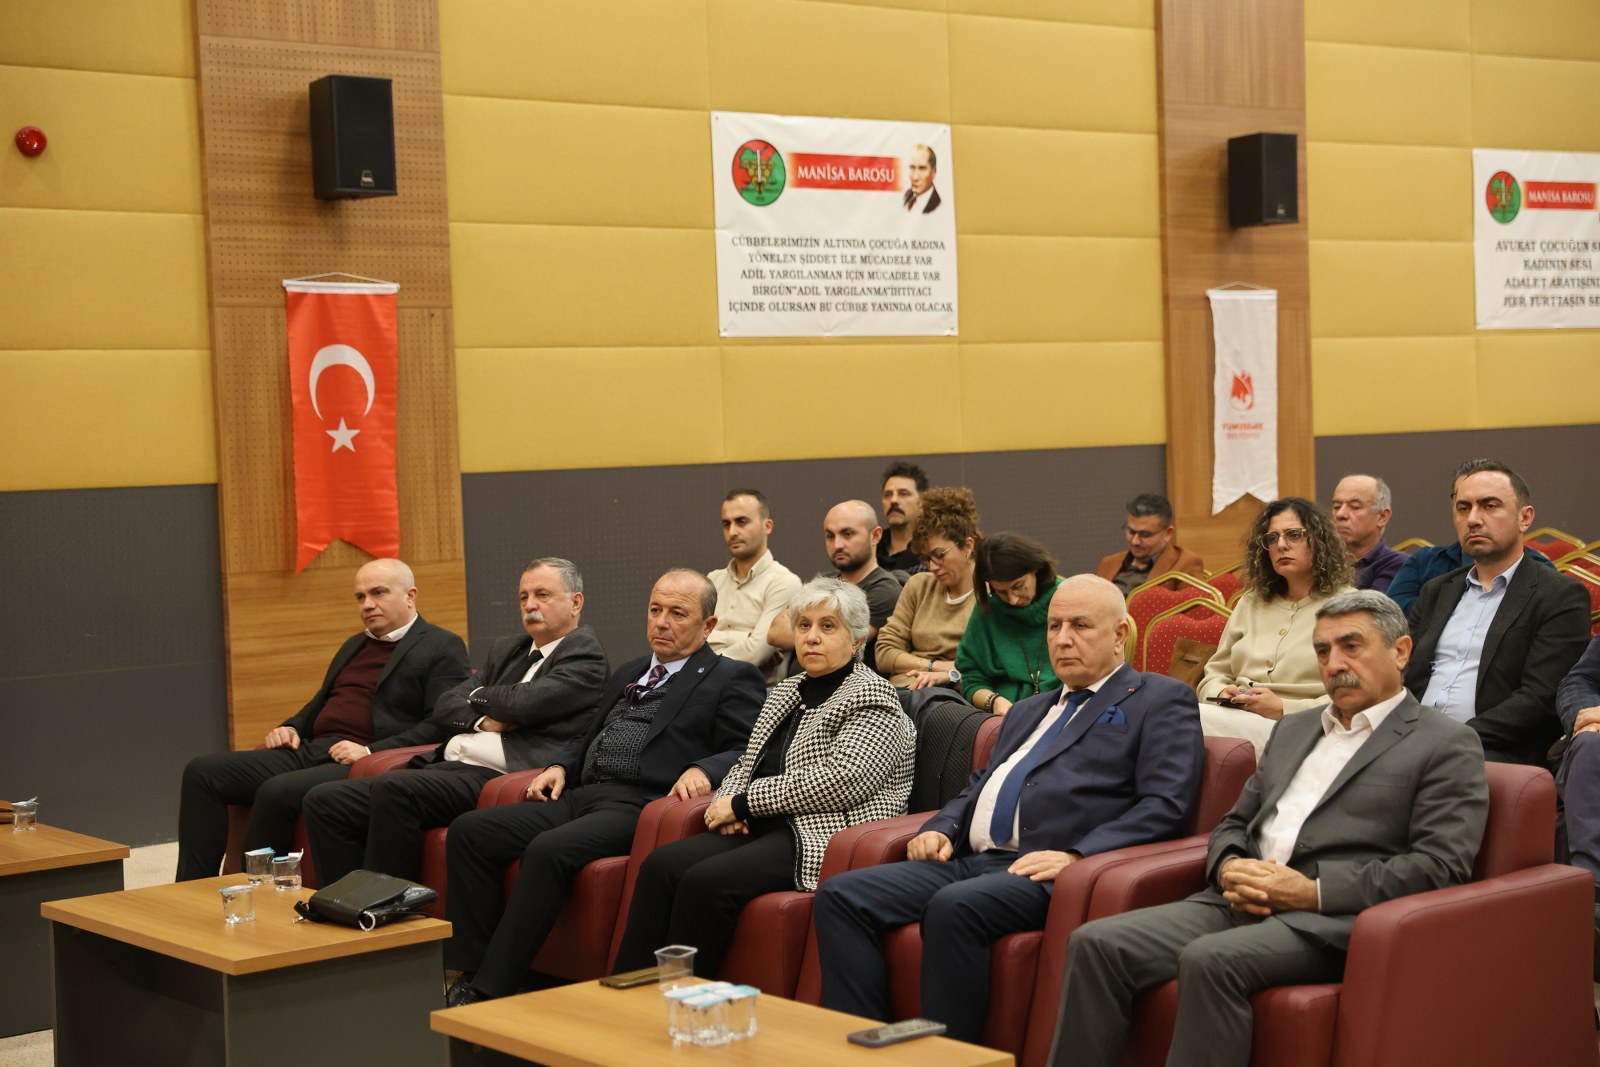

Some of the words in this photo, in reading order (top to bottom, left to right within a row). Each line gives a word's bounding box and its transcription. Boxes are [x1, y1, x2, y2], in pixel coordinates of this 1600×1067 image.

[797, 163, 846, 181] MANİSA
[848, 166, 896, 183] BAROSU
[731, 235, 820, 249] CÜBBELERİMİZİN
[823, 238, 867, 249] ALTINDA
[868, 237, 909, 251] ÇOCUĞA
[911, 240, 946, 251] KADINA
[1495, 240, 1536, 252] AVUKAT
[747, 252, 797, 264] YÖNELEN
[799, 253, 838, 266] ŞİDDET
[840, 253, 857, 265] İLE
[859, 254, 912, 265] MÜCADELE
[914, 256, 933, 266] VAR
[740, 267, 766, 280] ADİL
[768, 269, 843, 280] YARGILANMAN
[845, 269, 865, 283] İÇİN
[922, 271, 941, 281] VAR
[1503, 276, 1547, 289] ADALET
[728, 299, 766, 314] İÇİNDE
[768, 301, 817, 313] OLURSAN
[819, 301, 833, 313] BU
[834, 300, 869, 313] CÜBBE
[870, 302, 913, 313] YANINDA
[914, 302, 954, 313] OLACAK
